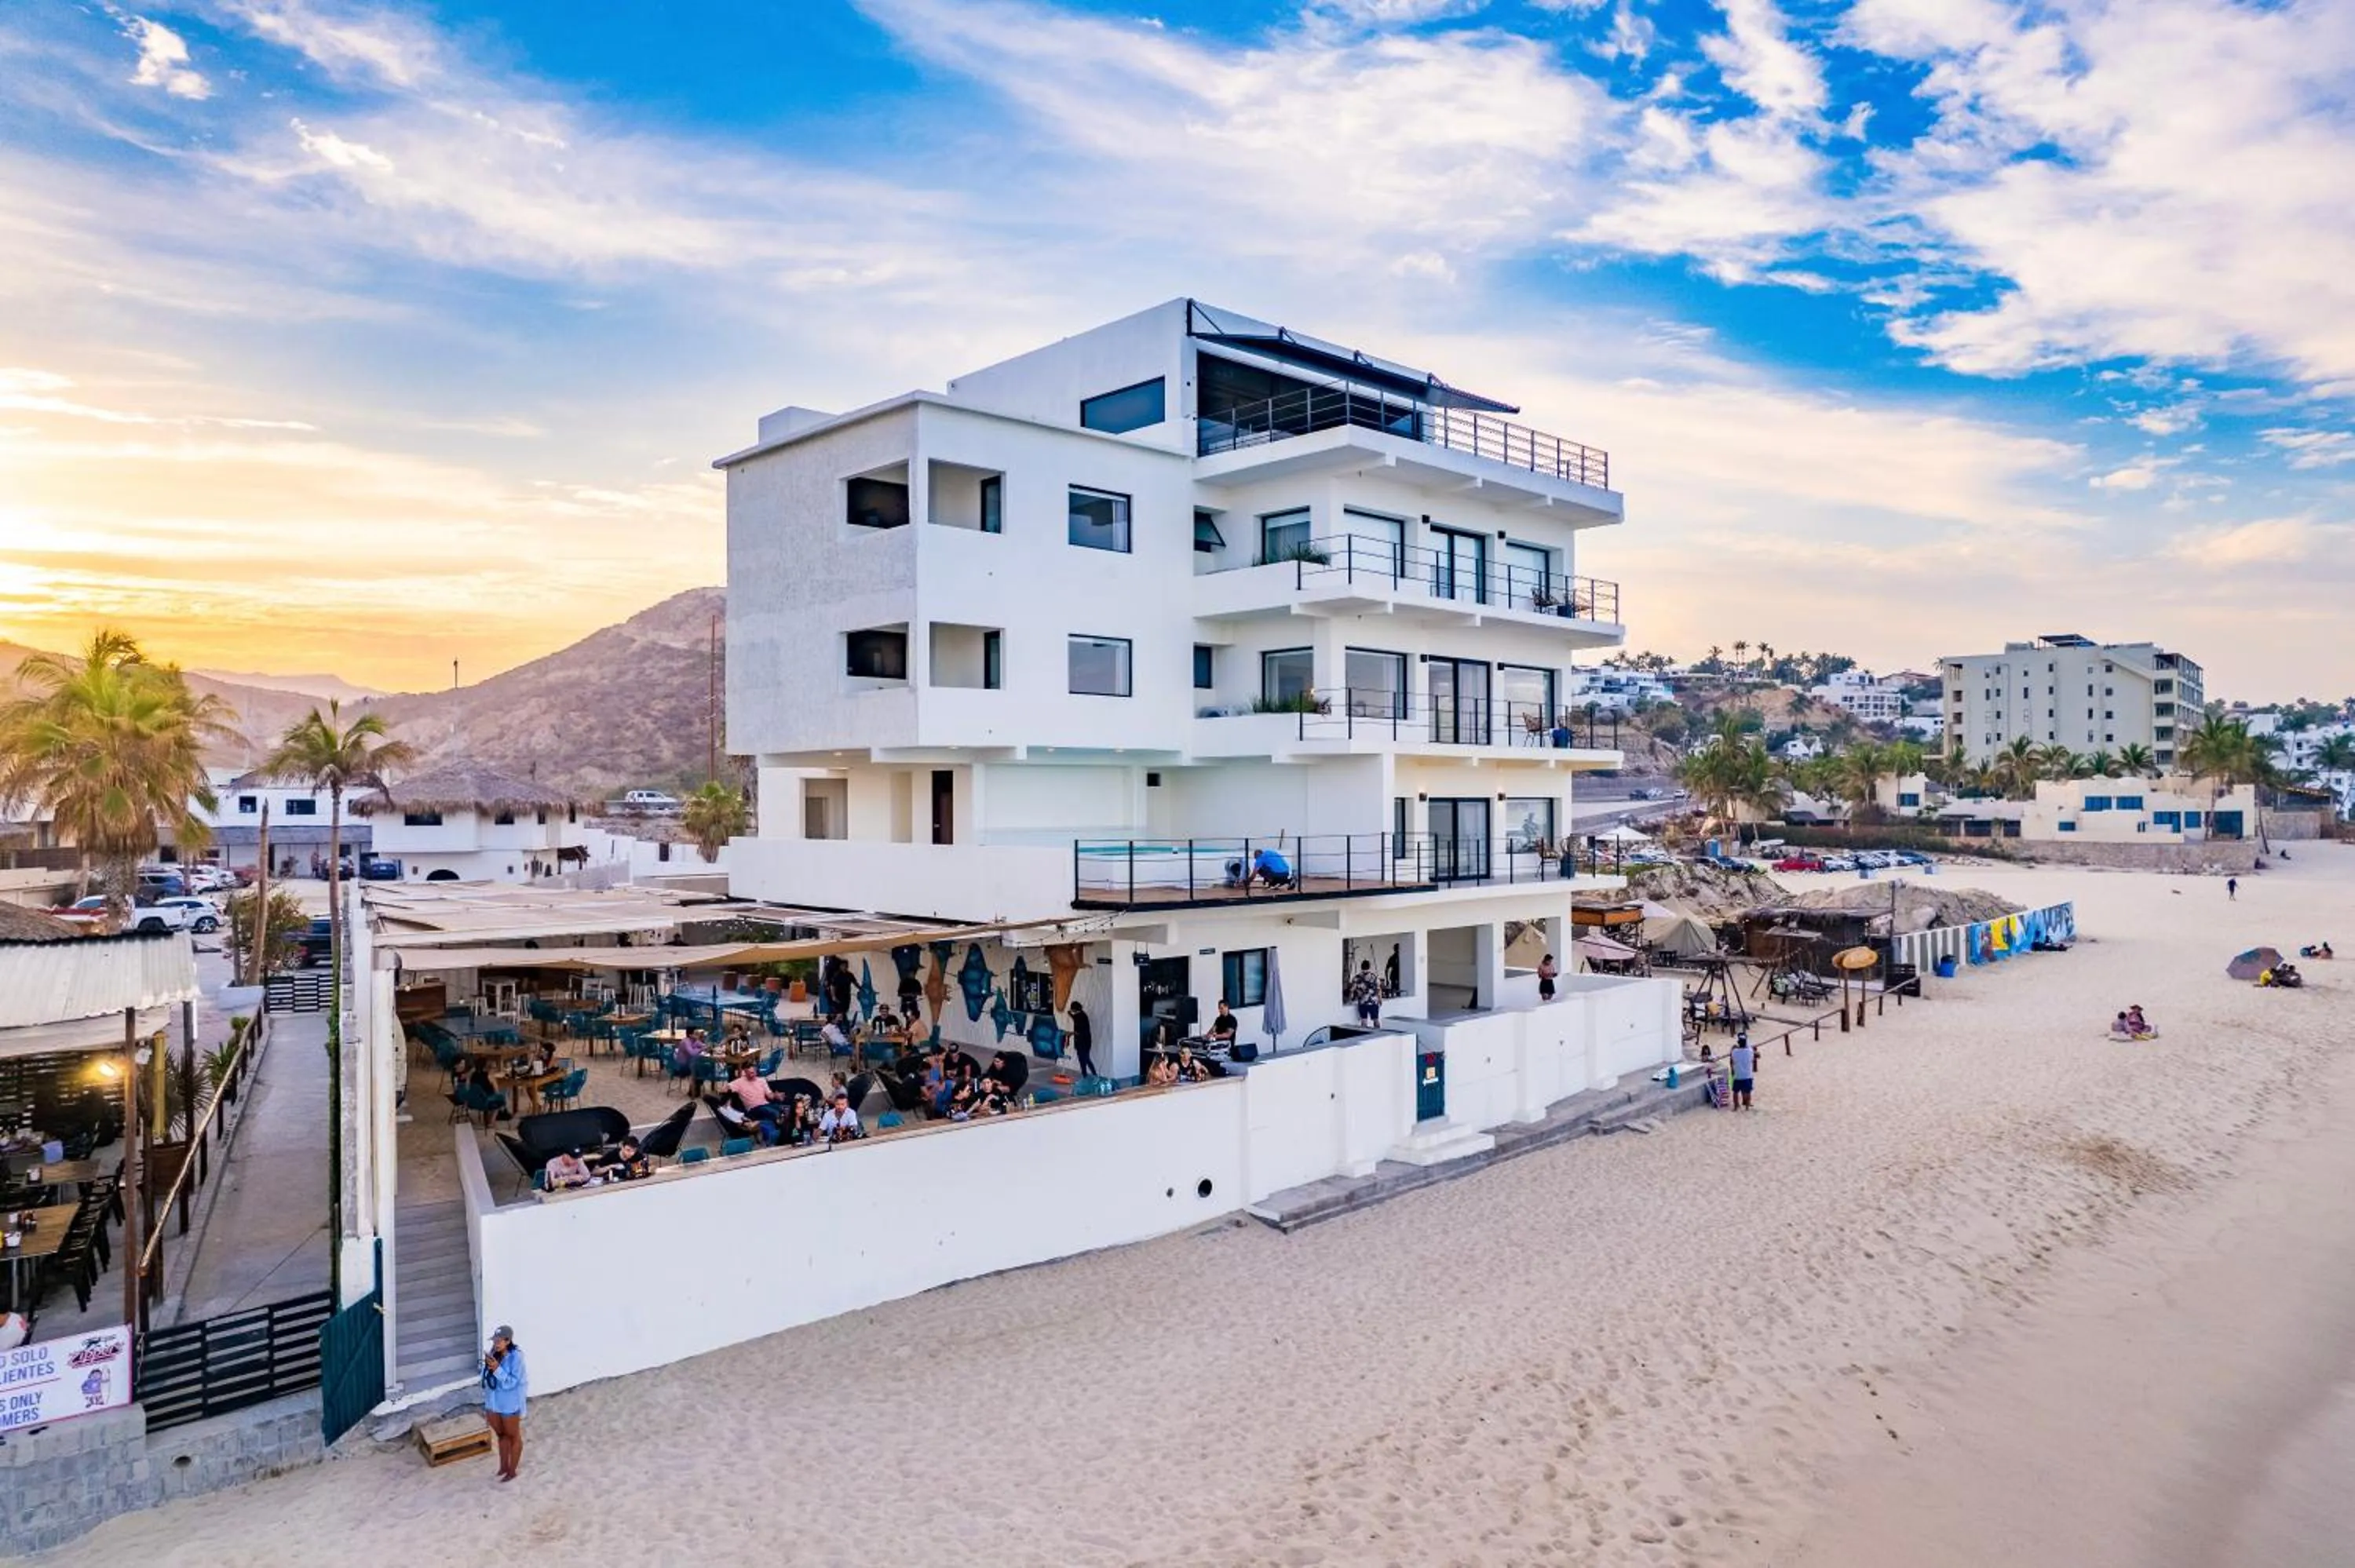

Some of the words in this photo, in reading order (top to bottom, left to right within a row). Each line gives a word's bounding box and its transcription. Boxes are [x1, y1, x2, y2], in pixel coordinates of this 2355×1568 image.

[11, 1347, 48, 1366] SOLO
[10, 1391, 42, 1410] ONLY
[0, 1407, 38, 1426] MERS
